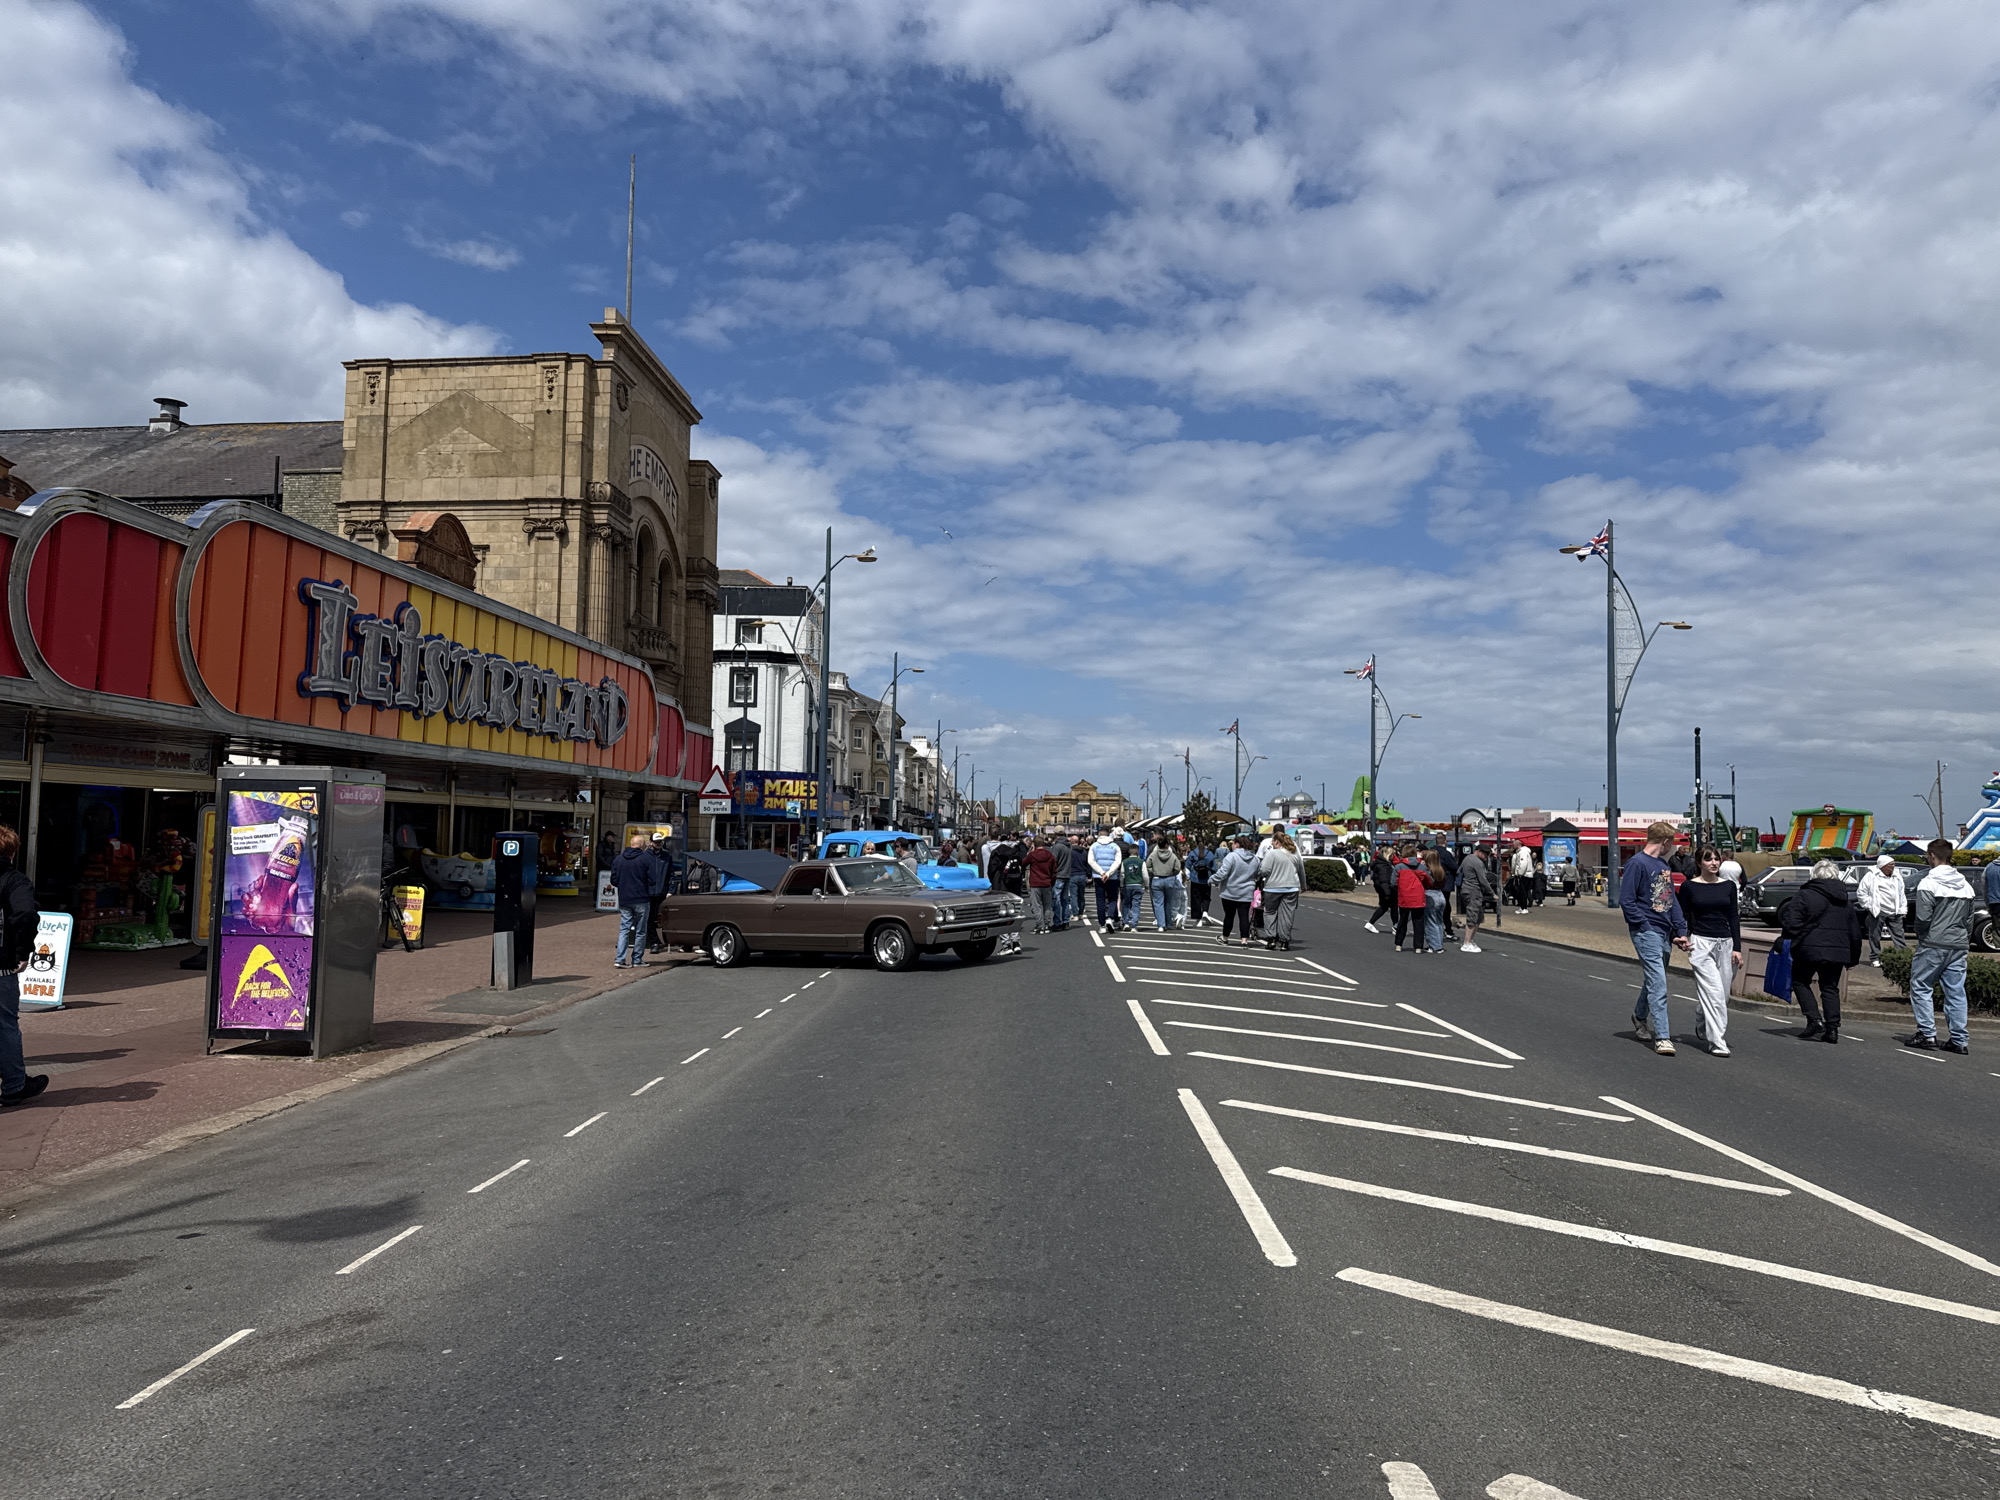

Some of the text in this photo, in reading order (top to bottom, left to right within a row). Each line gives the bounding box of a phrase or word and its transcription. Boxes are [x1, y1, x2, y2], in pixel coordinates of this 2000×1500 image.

[645, 451, 677, 518] EMPIRE
[157, 751, 192, 770] ZONE
[506, 843, 516, 853] P
[25, 976, 56, 984] AVAILABLE
[23, 983, 56, 997] HERE
[244, 981, 272, 991] BACK FOR
[250, 988, 290, 999] THE BELIEVERS
